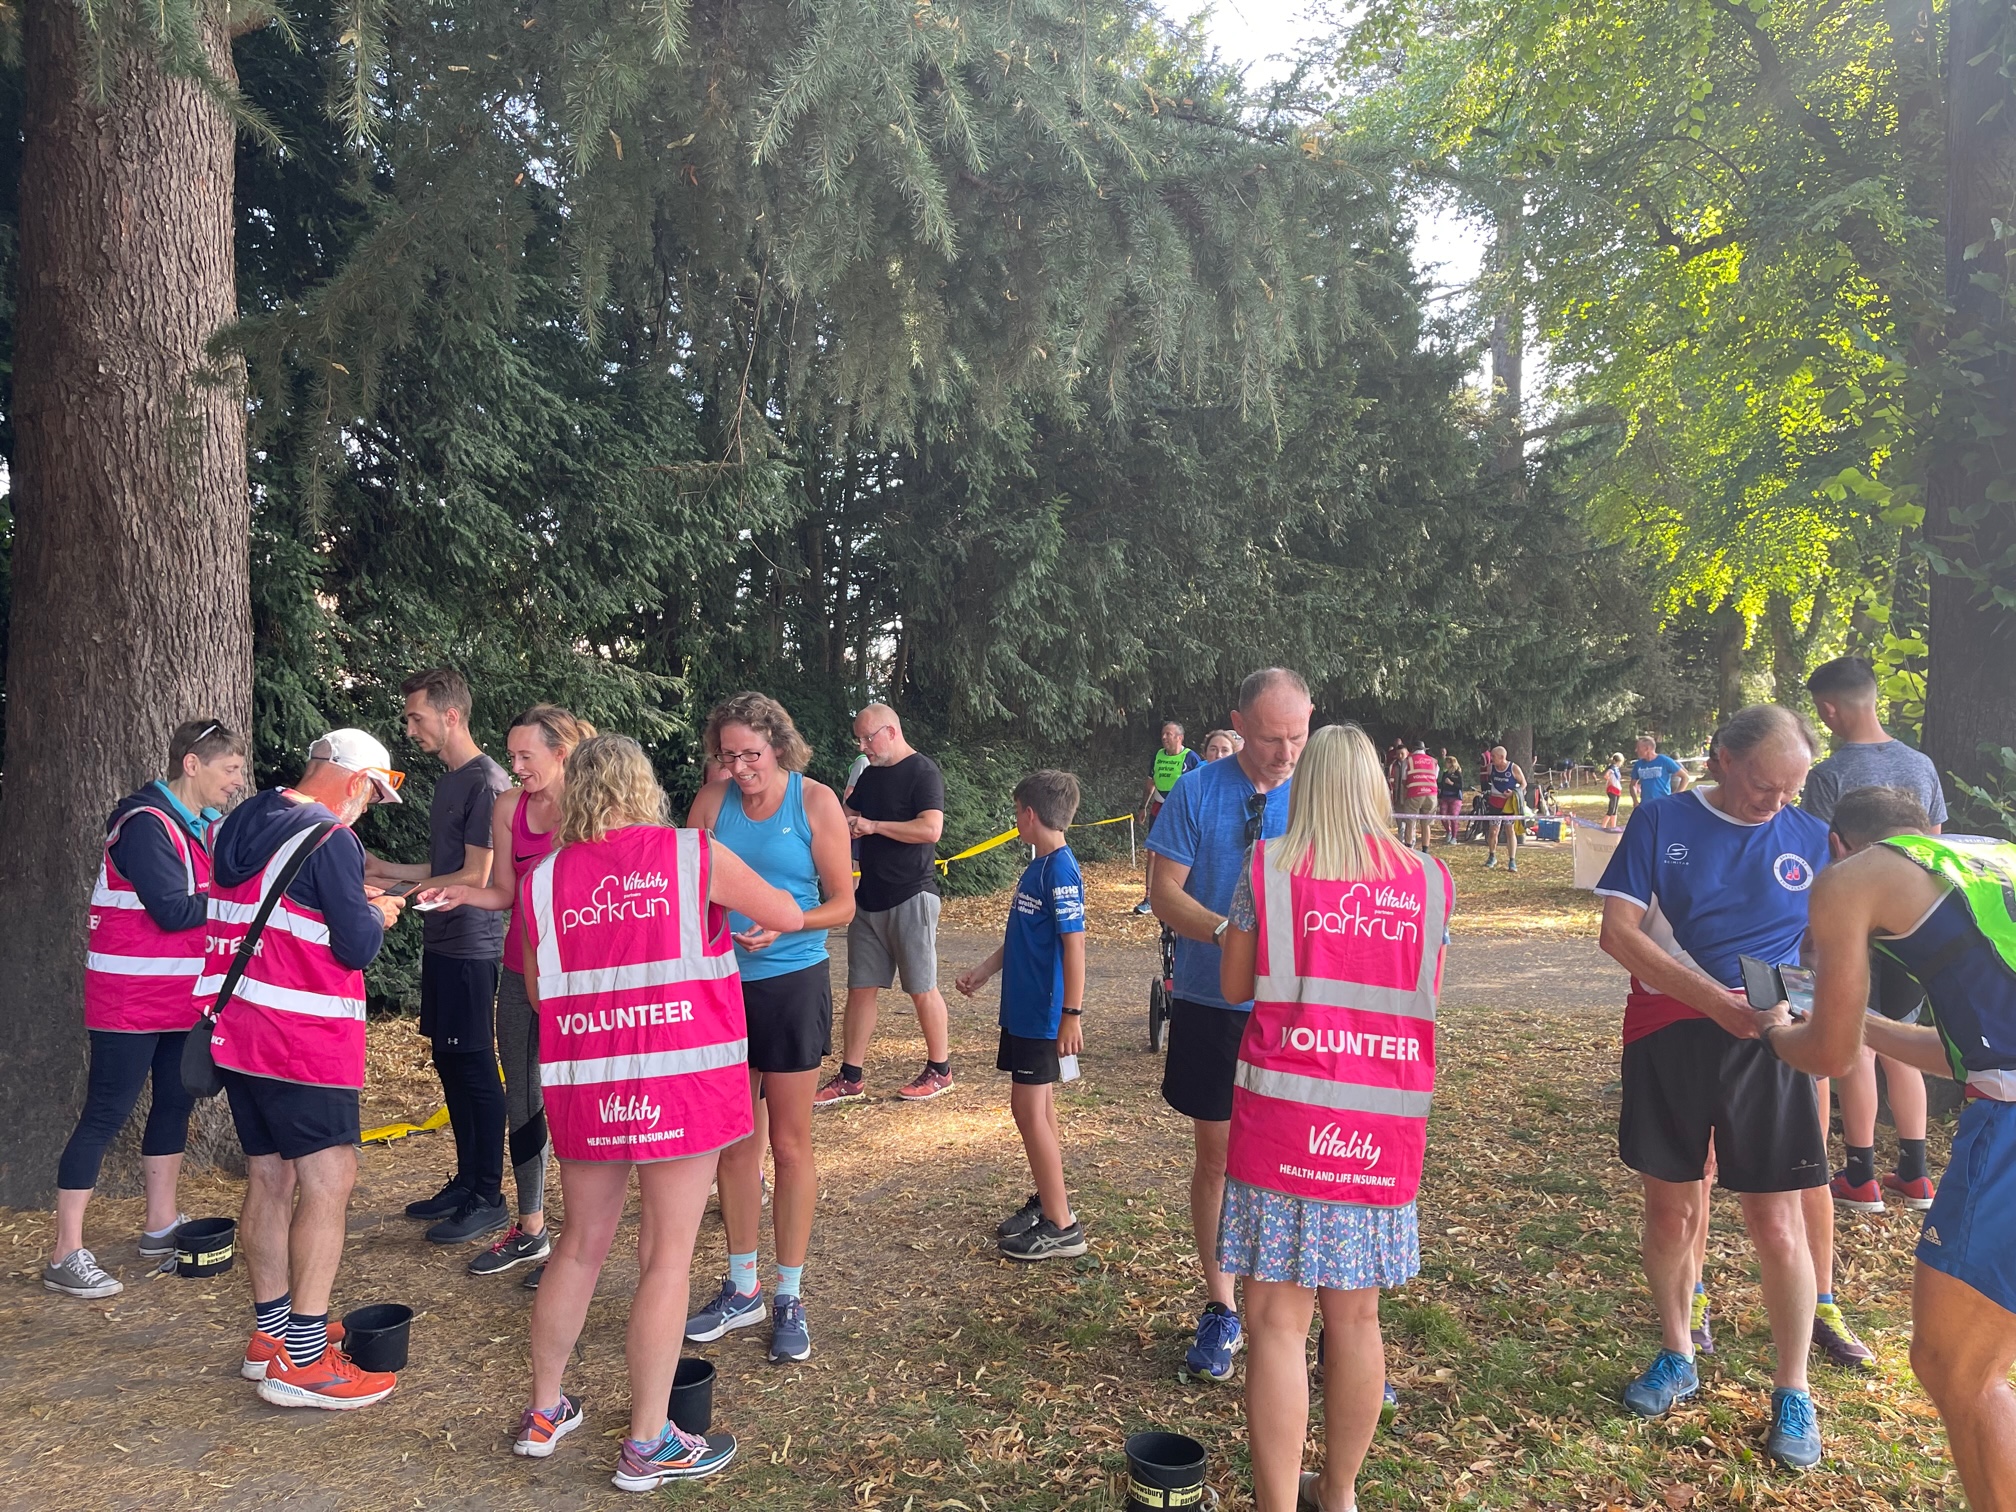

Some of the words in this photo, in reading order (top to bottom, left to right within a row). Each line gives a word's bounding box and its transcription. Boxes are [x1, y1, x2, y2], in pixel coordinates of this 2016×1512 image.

[623, 870, 668, 894] Vitality
[562, 891, 670, 935] parkrun
[1018, 900, 1041, 910] arathon
[1374, 886, 1420, 918] Vitality
[1304, 901, 1418, 944] parkrun
[556, 1000, 694, 1035] VOLUNTEER
[1280, 1027, 1420, 1061] VOLUNTEER
[599, 1092, 661, 1130] Vitality
[587, 1137, 612, 1146] HEALTH
[639, 1128, 684, 1144] INSURANCE
[1309, 1122, 1381, 1170] Vitality
[1280, 1164, 1314, 1180] HEALTH
[1315, 1171, 1334, 1182] AND
[1336, 1173, 1352, 1184] LIFE
[1352, 1174, 1396, 1187] INSURANCE
[1923, 1233, 1942, 1246] adidas
